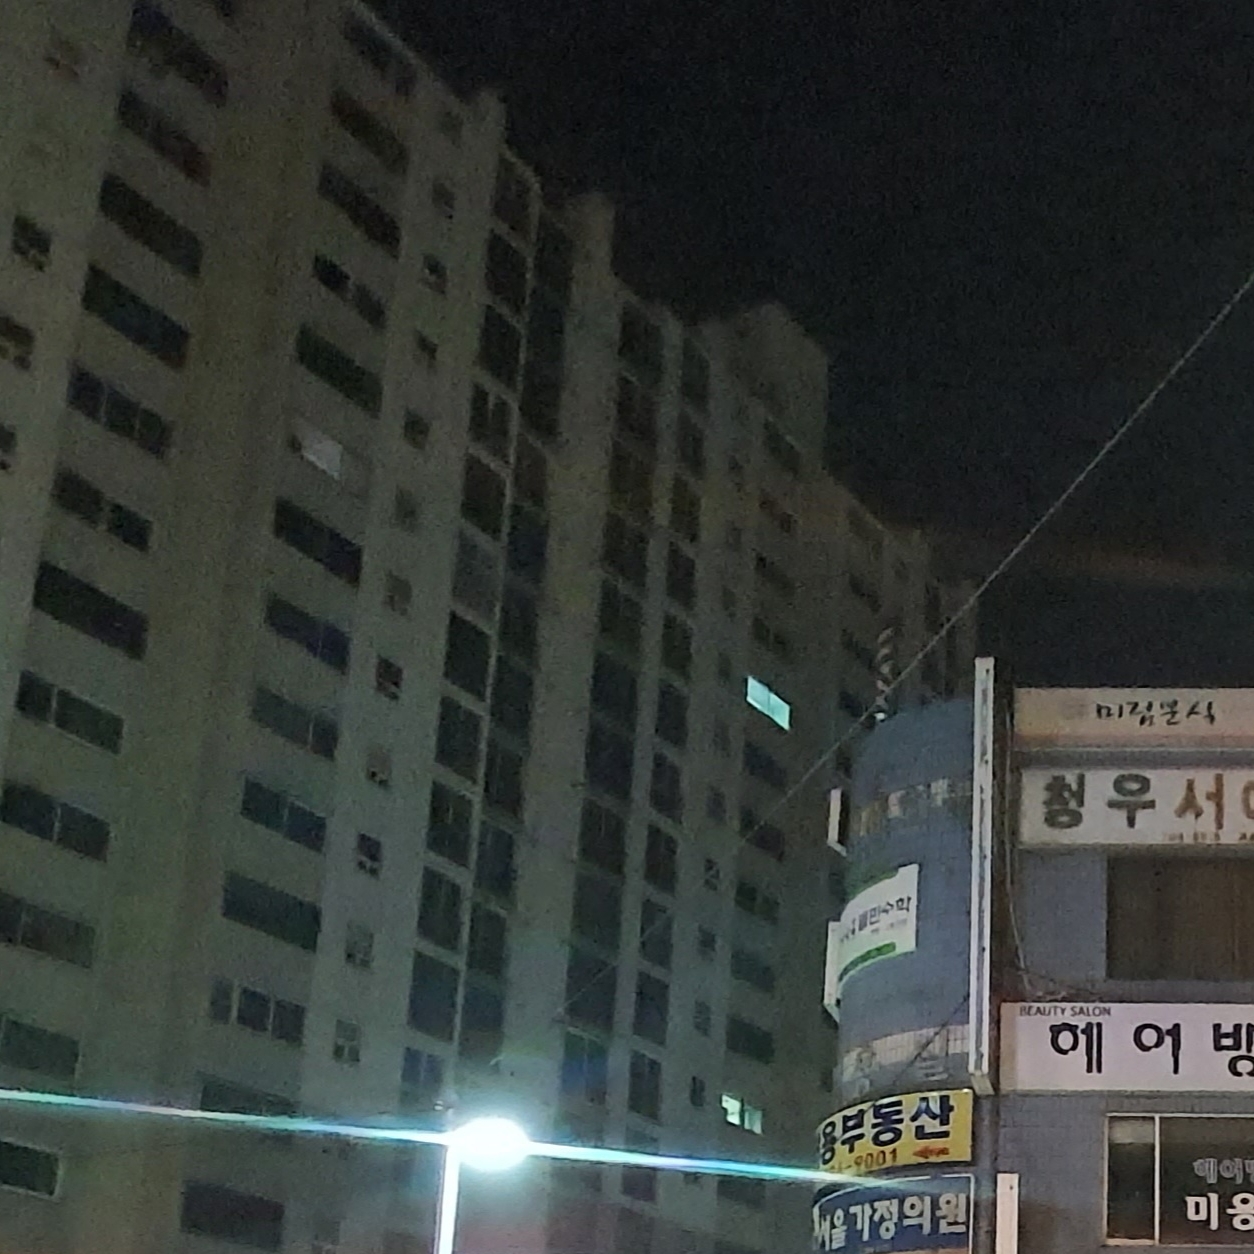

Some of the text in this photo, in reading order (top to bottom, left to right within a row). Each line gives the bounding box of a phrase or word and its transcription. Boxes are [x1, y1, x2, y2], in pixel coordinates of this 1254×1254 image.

[1019, 1005, 1112, 1017] BEAUTY SALON
[821, 1094, 954, 1166] 용부동산
[819, 1192, 967, 1251] 서울가정의원
